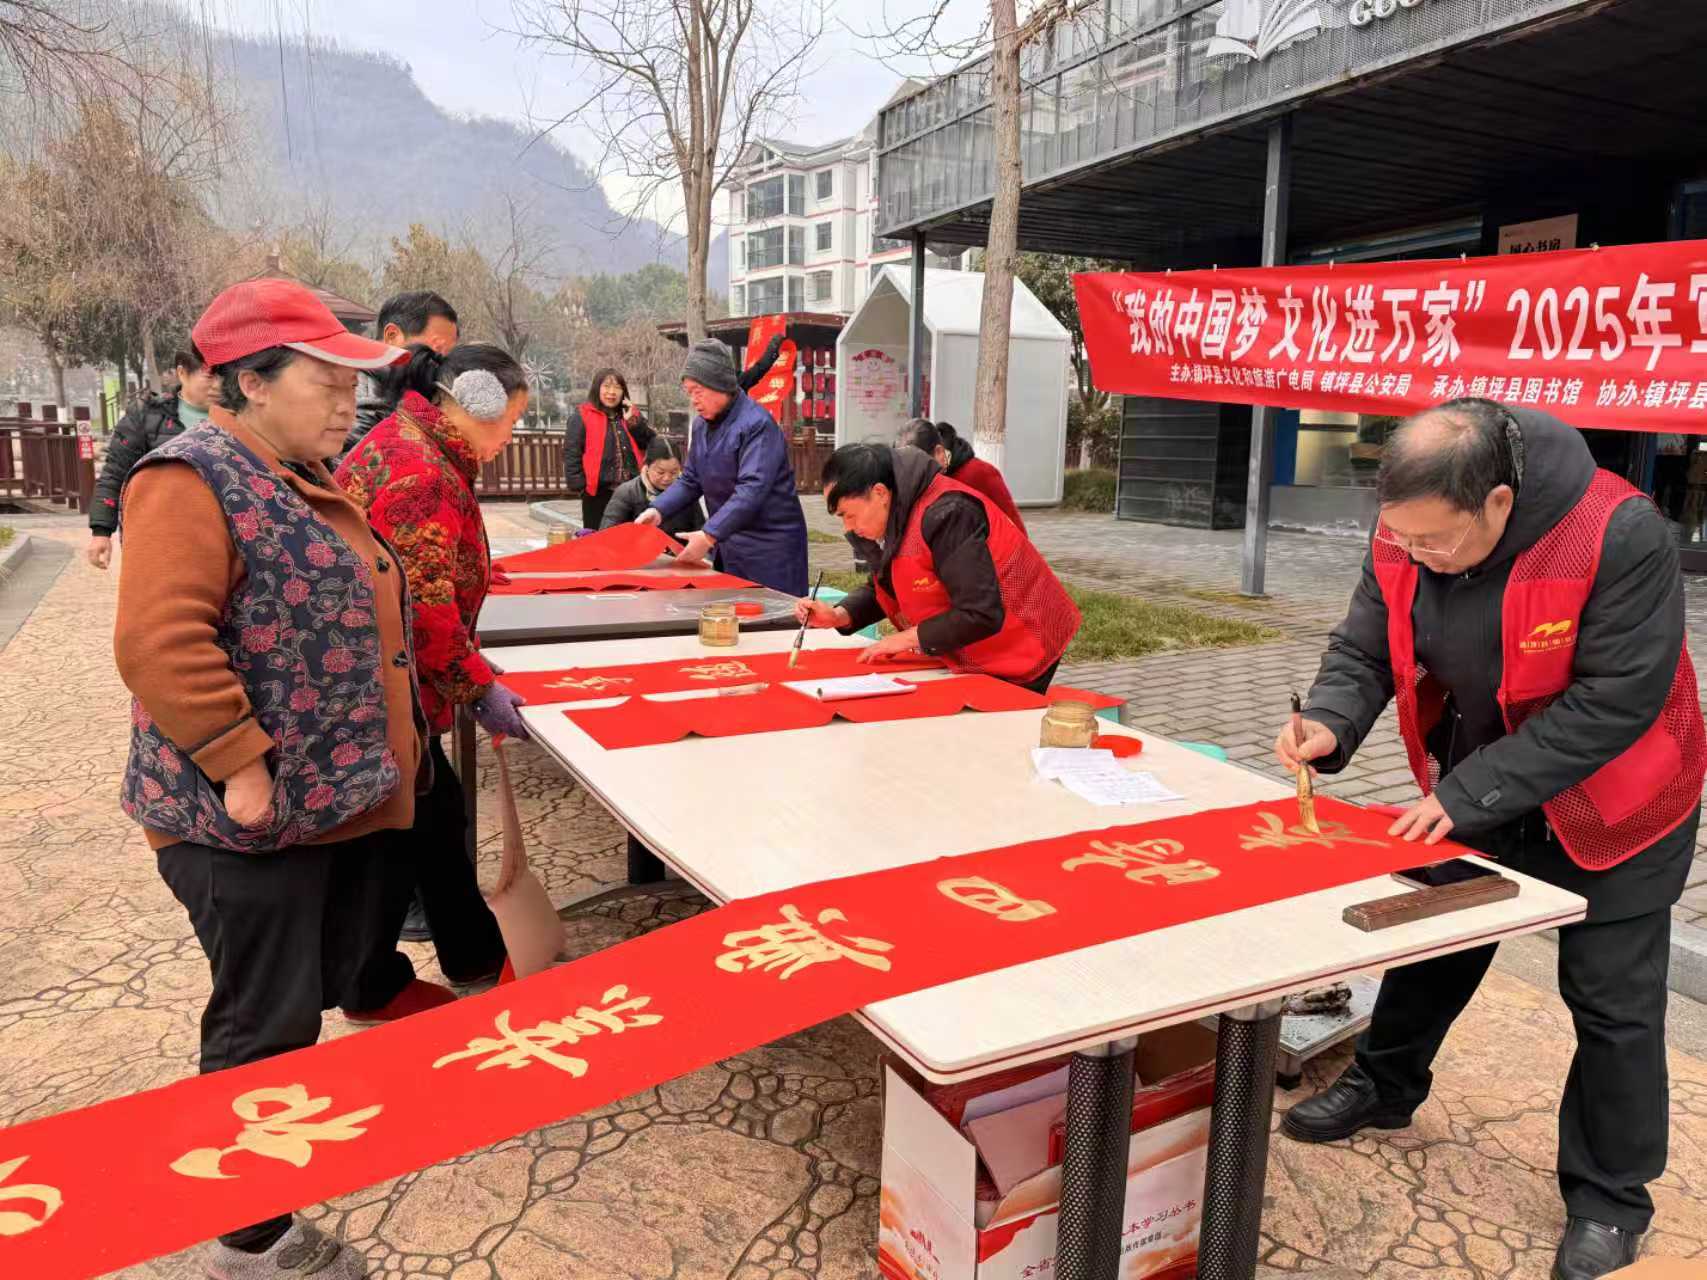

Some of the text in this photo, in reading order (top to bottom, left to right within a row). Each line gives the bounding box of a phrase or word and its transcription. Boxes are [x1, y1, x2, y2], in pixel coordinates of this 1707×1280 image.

[1321, 370, 1412, 396] 镇坪县公安局
